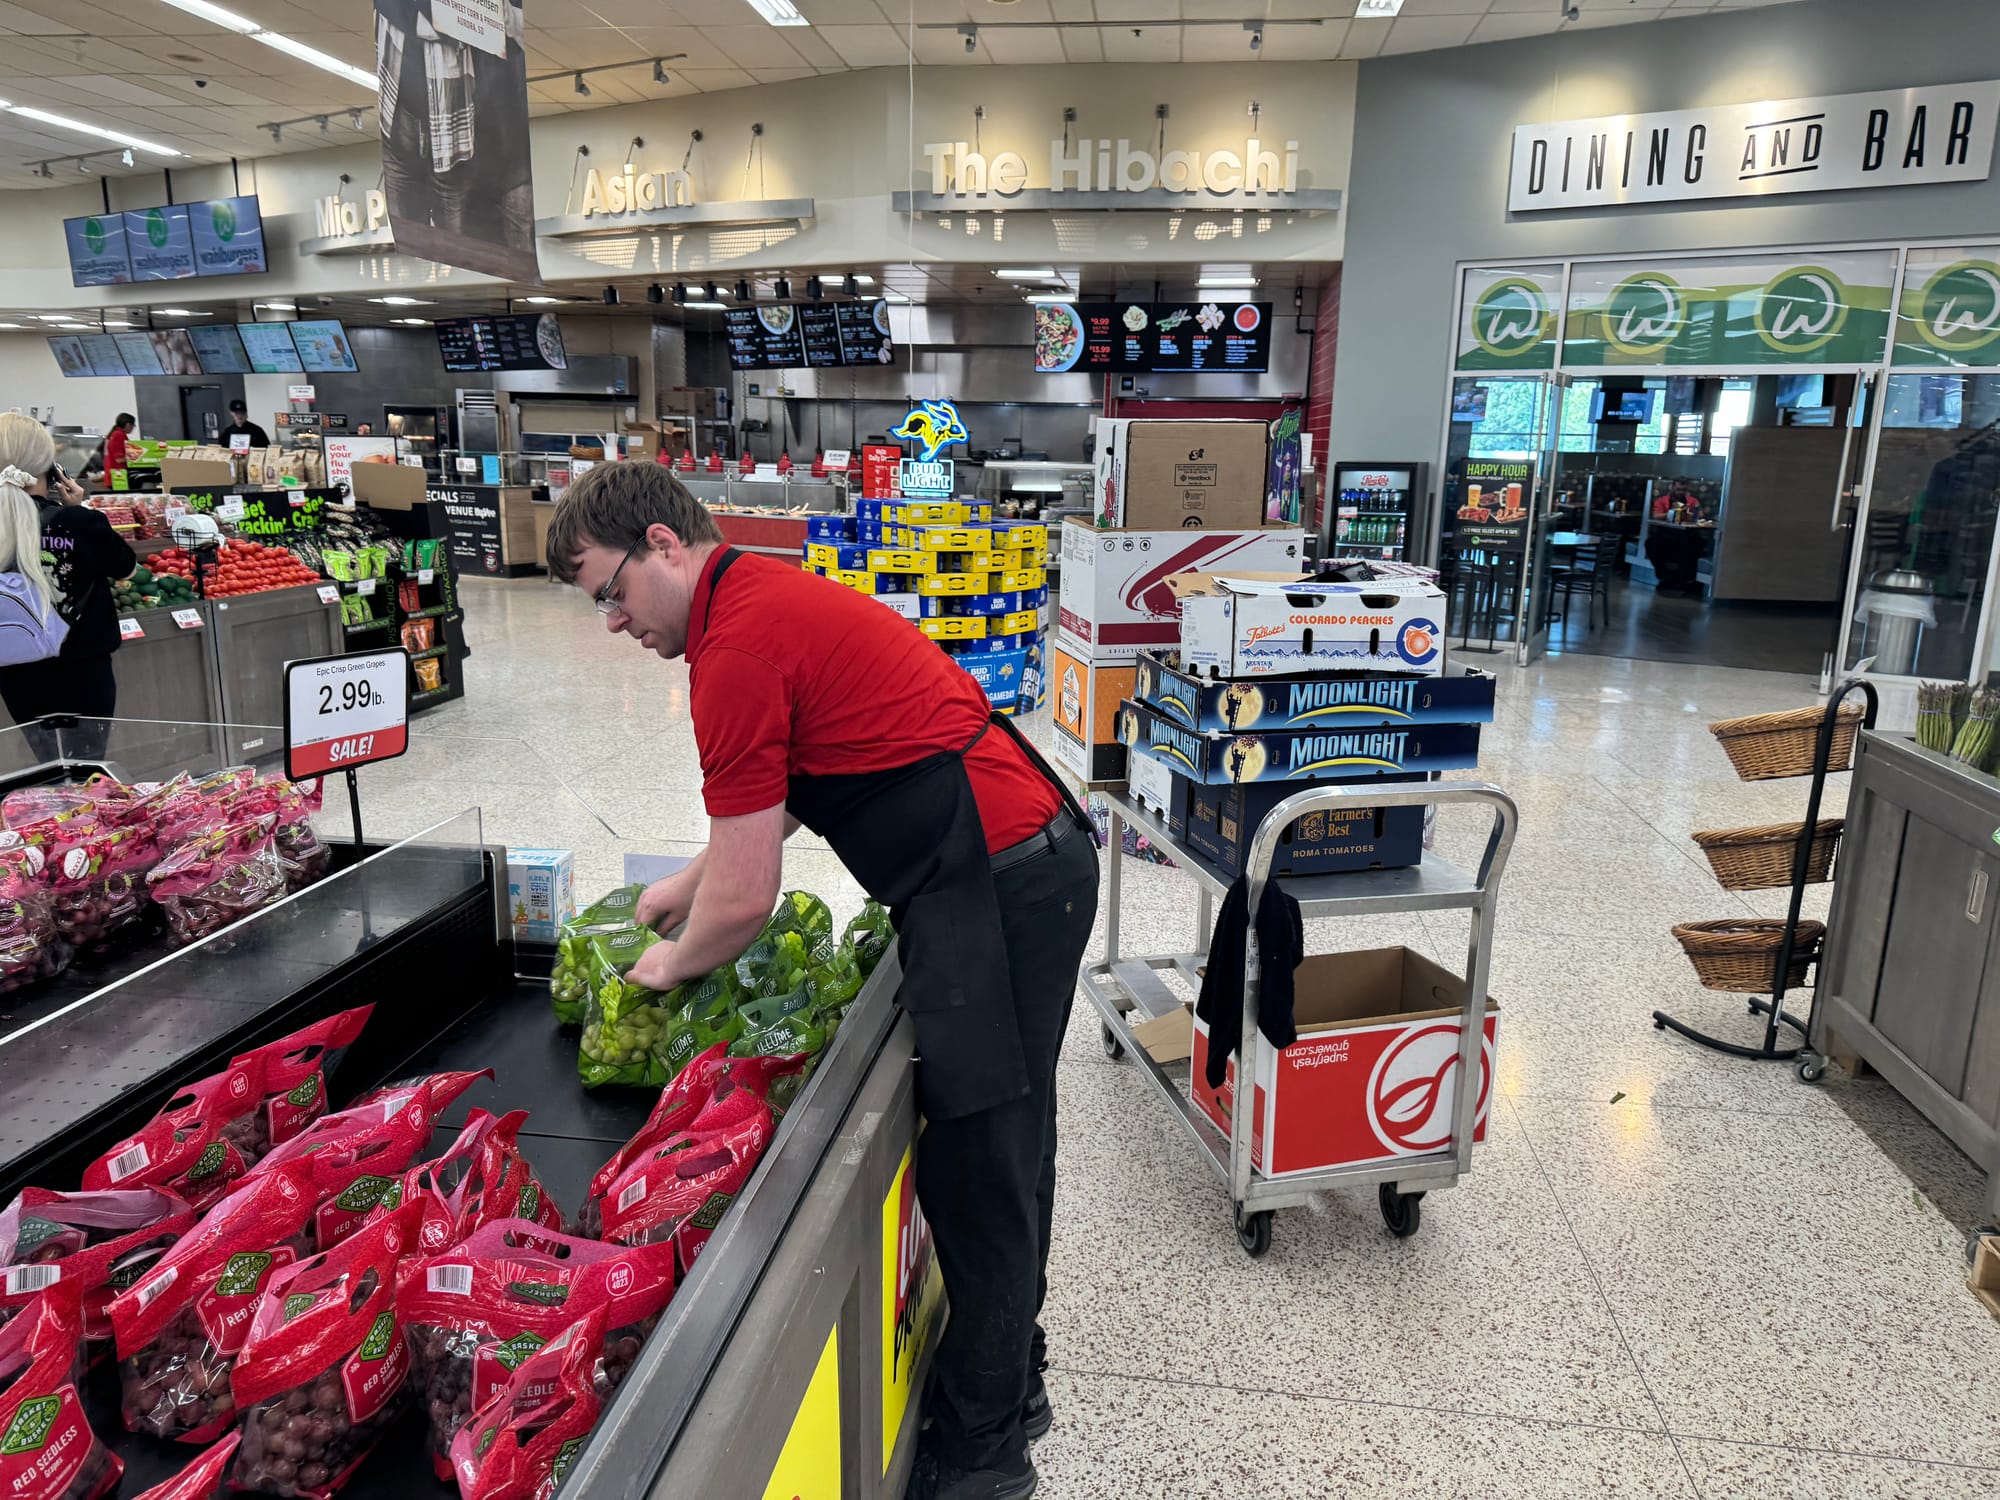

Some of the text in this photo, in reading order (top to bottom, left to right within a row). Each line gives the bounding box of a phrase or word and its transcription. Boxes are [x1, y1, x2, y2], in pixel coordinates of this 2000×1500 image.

[1528, 101, 1975, 196] DINING AND BAR
[924, 138, 1299, 195] The Hibachi
[582, 163, 695, 217] Asian
[314, 195, 361, 239] Mia
[329, 443, 346, 451] Get
[330, 451, 352, 459] your
[331, 460, 344, 468] flu
[331, 468, 350, 476] sho
[910, 462, 944, 475] BUD
[1467, 464, 1528, 477] HAPPY HOUR
[902, 474, 951, 489] LIGHT
[426, 490, 459, 503] ECIALS
[445, 505, 473, 517] VENUE
[239, 518, 288, 534] rackin'
[41, 536, 74, 551] TION
[385, 578, 397, 643] PISTACHIOS
[1289, 616, 1394, 626] COLORADO PEACHES
[1243, 622, 1286, 648] Talbott's
[316, 660, 386, 676] Epic Crisp Green Grapes
[970, 668, 988, 676] BUD
[989, 690, 1016, 701] GAMEDAY
[1158, 670, 1198, 720] MOONLIGHT
[1288, 681, 1419, 717] MOONLIGHT
[329, 734, 374, 762] SALE!
[1150, 718, 1202, 770] MOONLIGHT
[1289, 732, 1410, 770] MOONLIGHT
[1329, 808, 1374, 822] Farmer's
[1328, 824, 1350, 837] Best
[1292, 844, 1374, 858] ROMA TOMATOES
[510, 884, 520, 896] R
[668, 1032, 695, 1060] LLUME
[756, 1028, 793, 1054] ILLUME
[1286, 1040, 1350, 1058] growers.com
[1292, 1051, 1348, 1070] superfresh
[348, 1180, 380, 1196] BASKET
[350, 1192, 380, 1207] BUSHEL
[334, 1220, 350, 1236] RED
[234, 1270, 258, 1289] BUSHEL
[611, 1268, 628, 1280] PLU#
[612, 1279, 628, 1290] 4023
[226, 1308, 248, 1328] RED
[512, 1342, 543, 1350] BASKE
[362, 1374, 378, 1394] RED
[514, 1399, 541, 1408] Grapes
[13, 1402, 46, 1432] BASKET
[20, 1416, 51, 1446] BUSHEL
[12, 1466, 37, 1492] RED
[36, 1425, 78, 1471] SEEDLESS
[44, 1456, 63, 1478] Grapes
